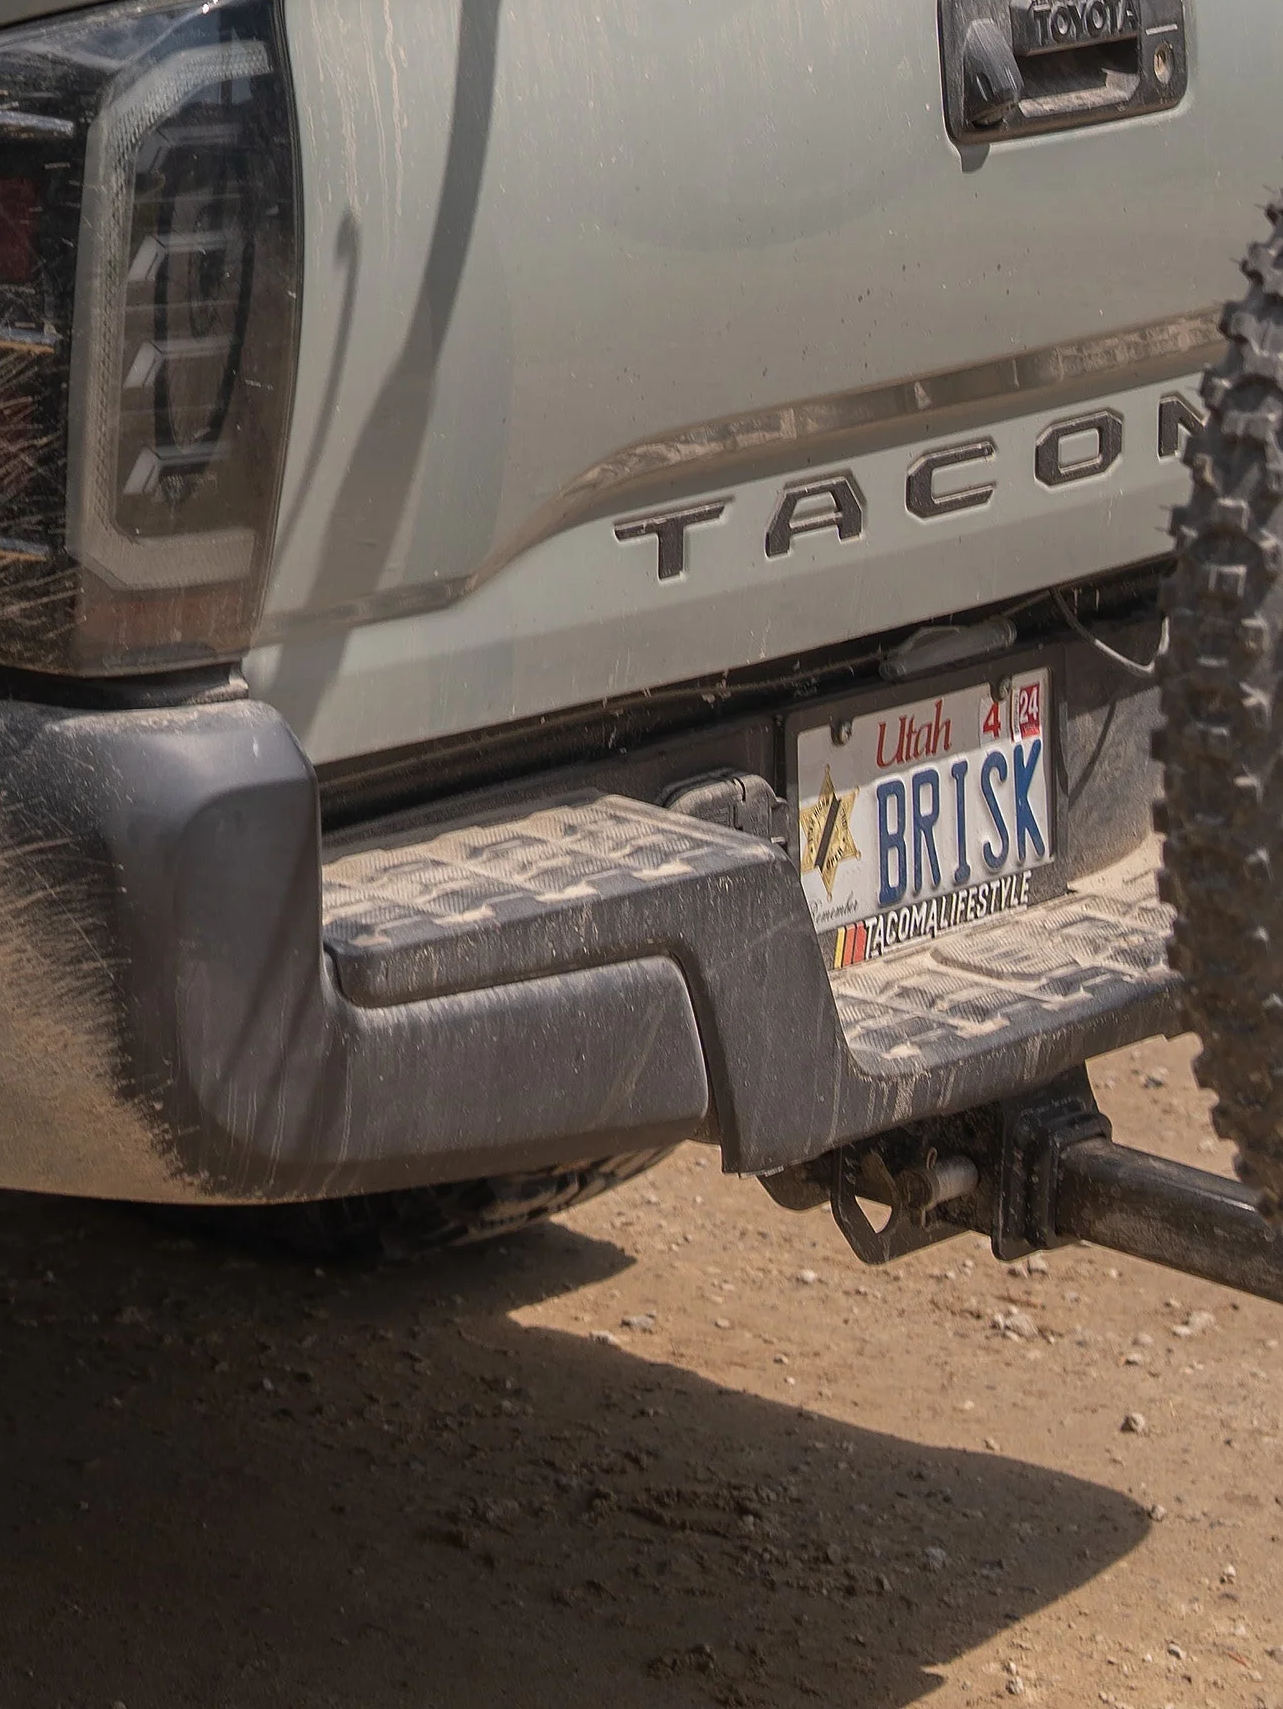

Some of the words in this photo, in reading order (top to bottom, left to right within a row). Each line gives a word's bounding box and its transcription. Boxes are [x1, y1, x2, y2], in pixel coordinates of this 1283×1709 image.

[982, 702, 1002, 739] 4
[1019, 687, 1040, 724] 24
[876, 699, 952, 768] Utah
[876, 739, 1046, 906] BRISK
